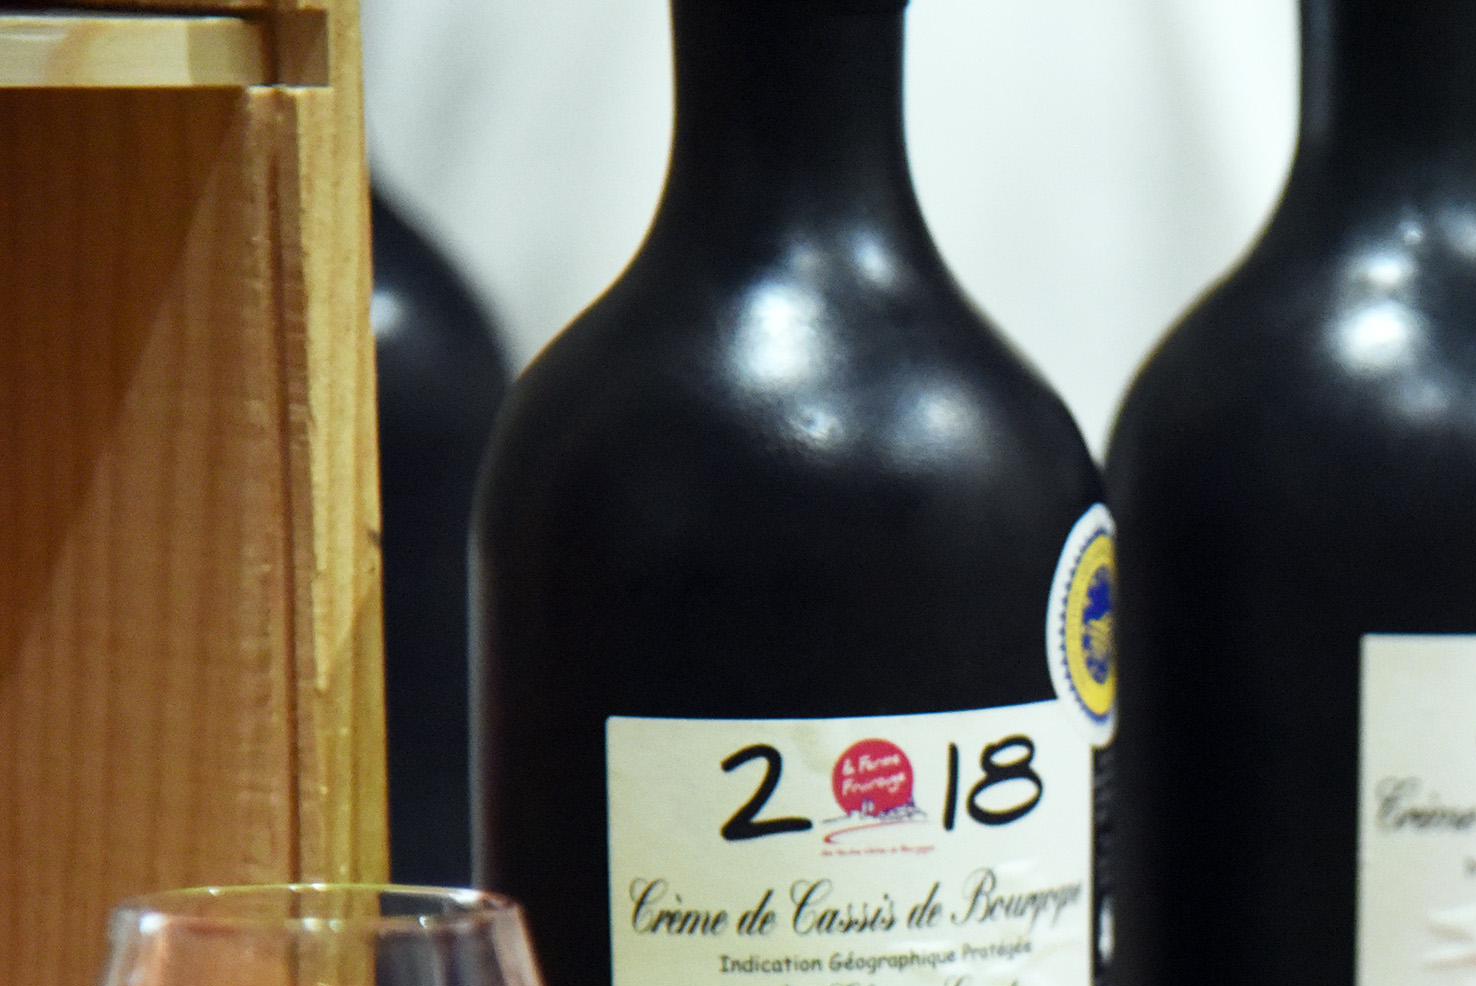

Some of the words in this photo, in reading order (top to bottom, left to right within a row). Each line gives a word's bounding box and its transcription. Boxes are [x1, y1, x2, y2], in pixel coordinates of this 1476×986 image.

[720, 742, 813, 842] 2
[942, 734, 1044, 832] 18
[629, 876, 729, 936] Crème
[736, 888, 777, 936] de
[789, 877, 896, 936] Cassis
[906, 880, 943, 930] de
[718, 953, 823, 974] Indication
[828, 945, 956, 976] Géographique
